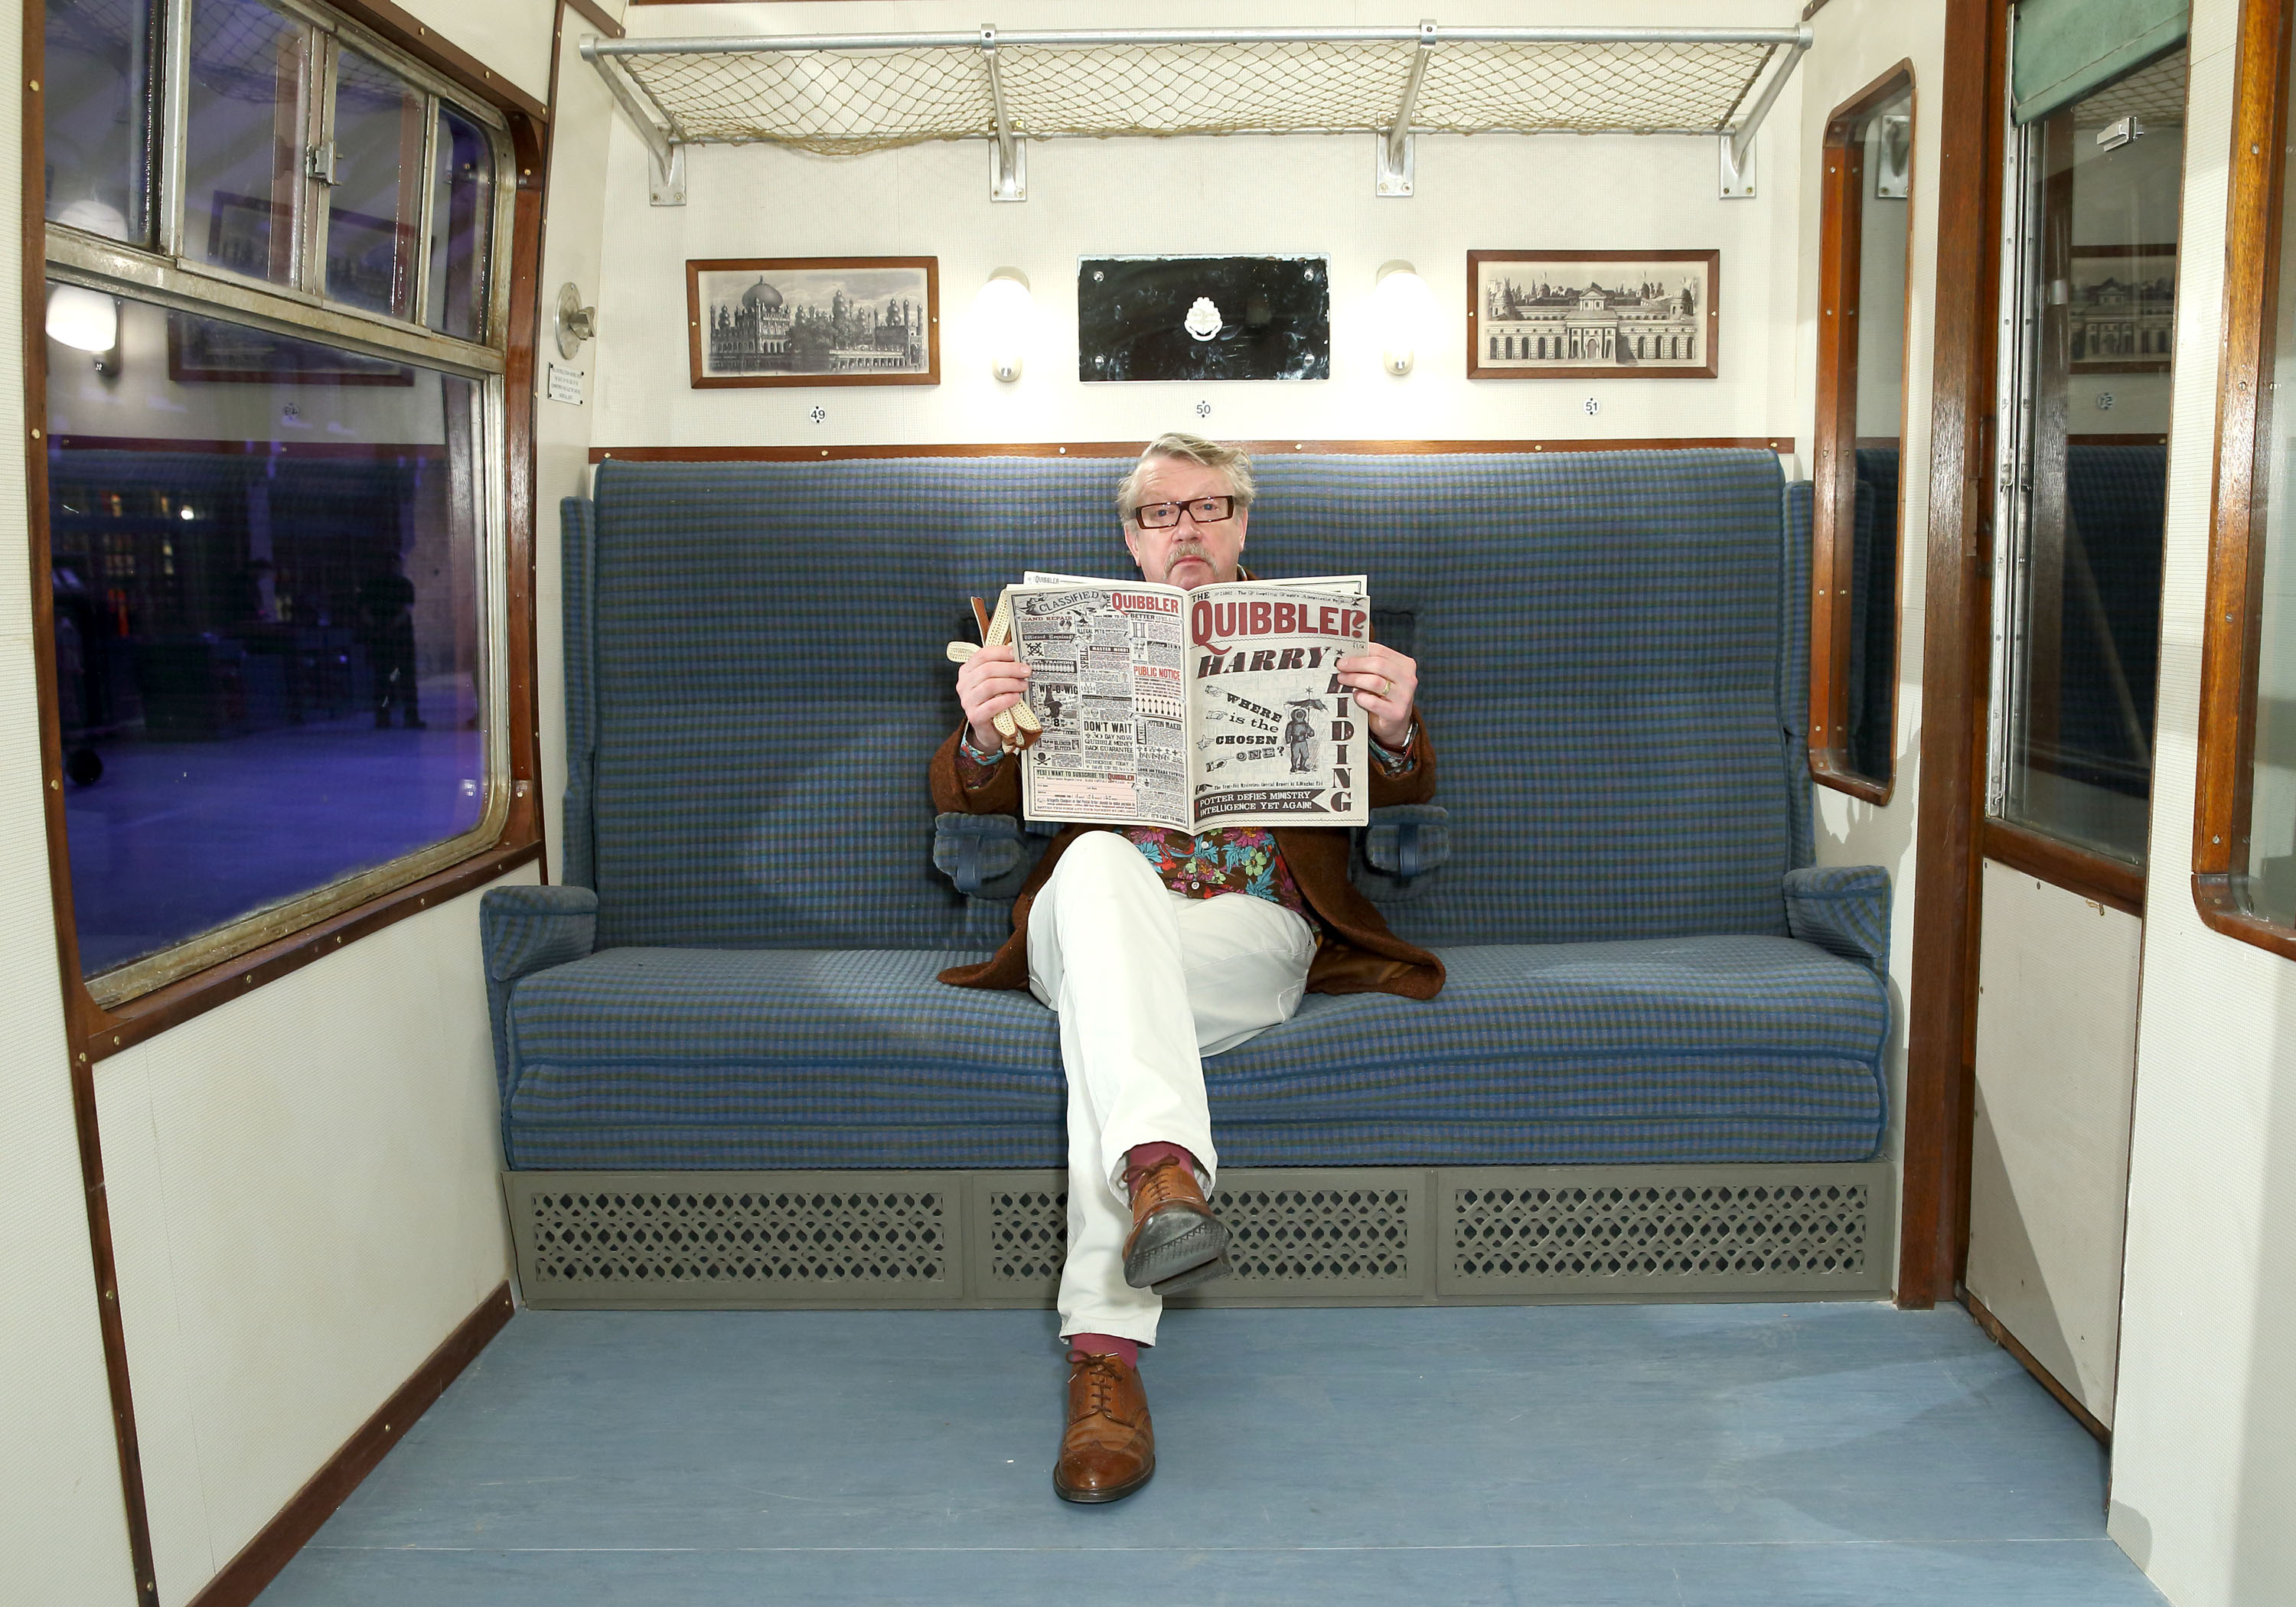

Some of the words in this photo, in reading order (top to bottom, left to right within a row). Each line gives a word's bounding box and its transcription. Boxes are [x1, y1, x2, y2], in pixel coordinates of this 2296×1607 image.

[810, 409, 825, 419] 49
[1196, 404, 1211, 414] 50
[1586, 402, 1597, 411] 51
[1039, 591, 1100, 612] CLASSIFIED
[1112, 592, 1179, 615] QUIBBLER
[1192, 592, 1210, 603] THE
[1195, 646, 1333, 680] HARRY
[1133, 665, 1157, 677] PUBLIC
[1159, 668, 1181, 681] NOTICE
[1227, 693, 1283, 722] WHERE
[1084, 721, 1108, 732] DON'T
[1112, 722, 1132, 734] WAIT
[1228, 712, 1246, 724] is
[1251, 719, 1279, 732] the
[1215, 735, 1277, 745] CHOSEN
[1107, 773, 1135, 781] QUIBBLER
[1200, 794, 1234, 807] POTTER
[1237, 792, 1267, 801] DEFIES
[1270, 790, 1311, 800] MINISTRY
[1200, 802, 1256, 817] INTELLIGENCE
[1260, 801, 1280, 810] YET
[1283, 801, 1313, 810] AGAIN!
